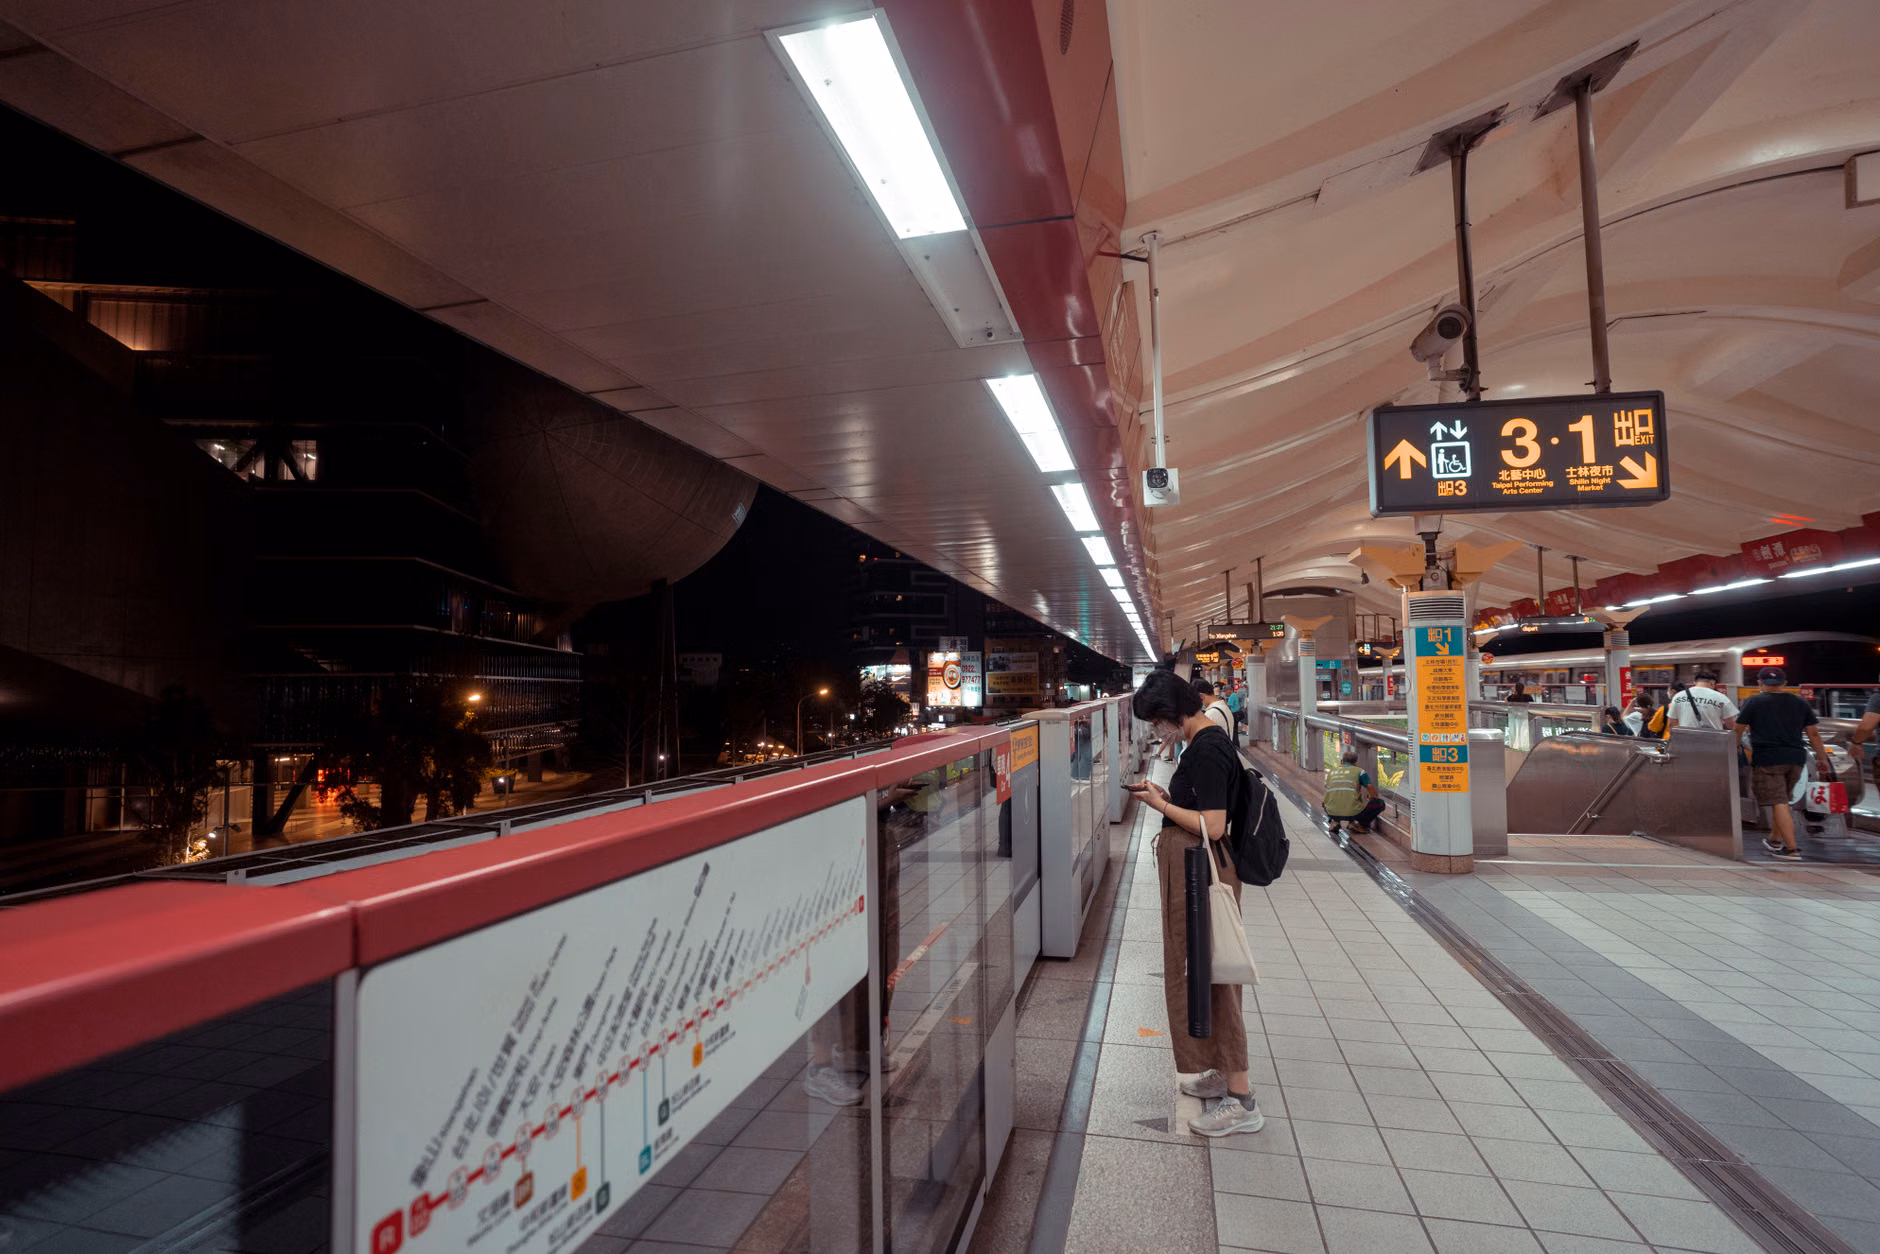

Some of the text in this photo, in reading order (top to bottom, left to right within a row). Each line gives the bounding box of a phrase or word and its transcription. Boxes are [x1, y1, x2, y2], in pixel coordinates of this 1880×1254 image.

[1613, 408, 1655, 448] 出口
[1634, 434, 1655, 446] EXIT
[1565, 465, 1614, 478] 士林夜市
[1455, 479, 1467, 496] 3
[1492, 480, 1554, 490] Taipei Performing
[1568, 477, 1611, 487] Shilin Night
[1502, 487, 1544, 496] Arts Center
[1577, 484, 1605, 493] Market
[1444, 627, 1453, 643] 1
[1447, 747, 1459, 762] 3
